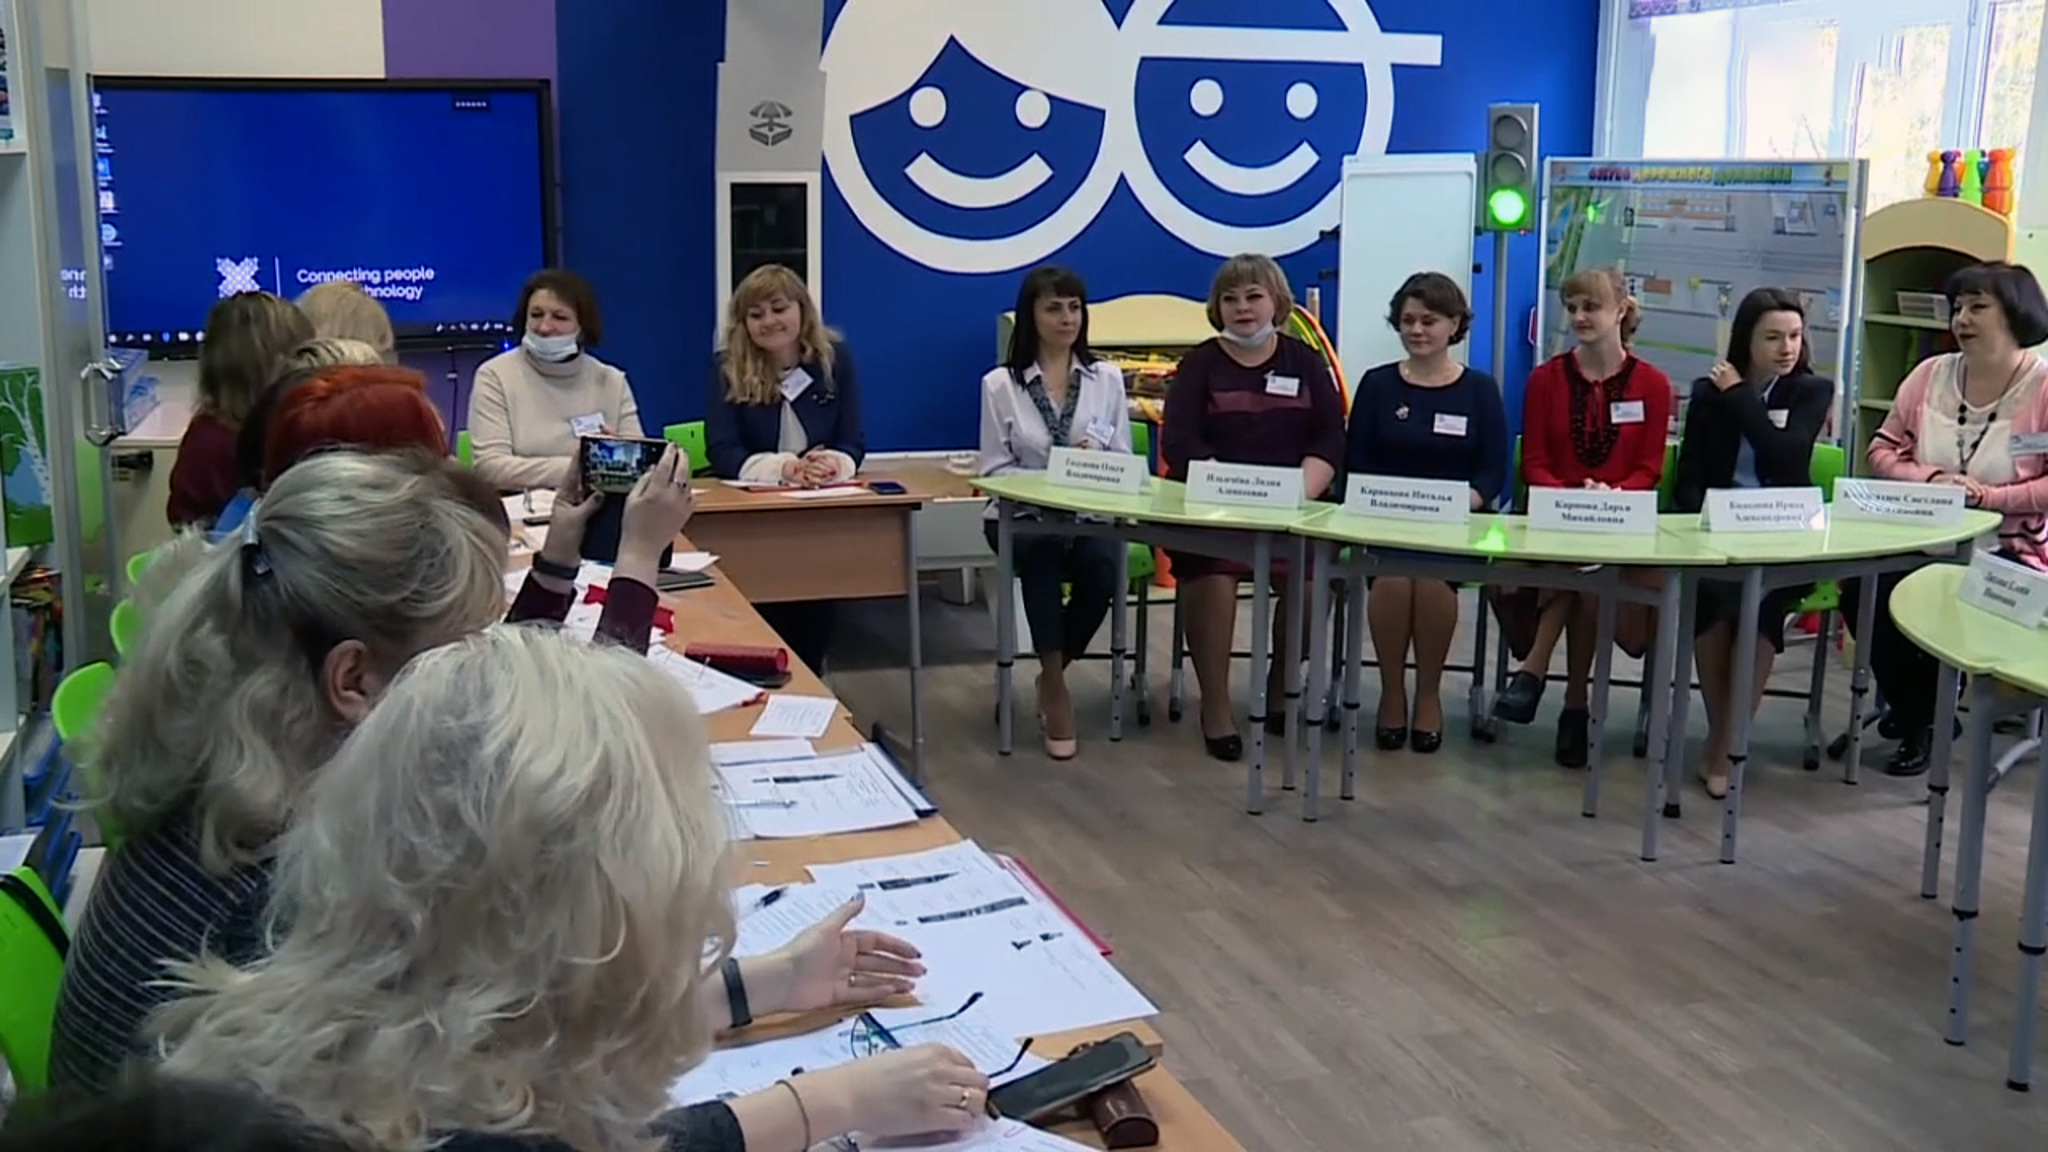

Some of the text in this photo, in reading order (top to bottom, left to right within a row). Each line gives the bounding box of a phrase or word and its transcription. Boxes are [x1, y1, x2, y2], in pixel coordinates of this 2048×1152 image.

[296, 265, 434, 284] Connecting people
[364, 283, 423, 301] hnology
[1561, 512, 1625, 524] Михайловна
